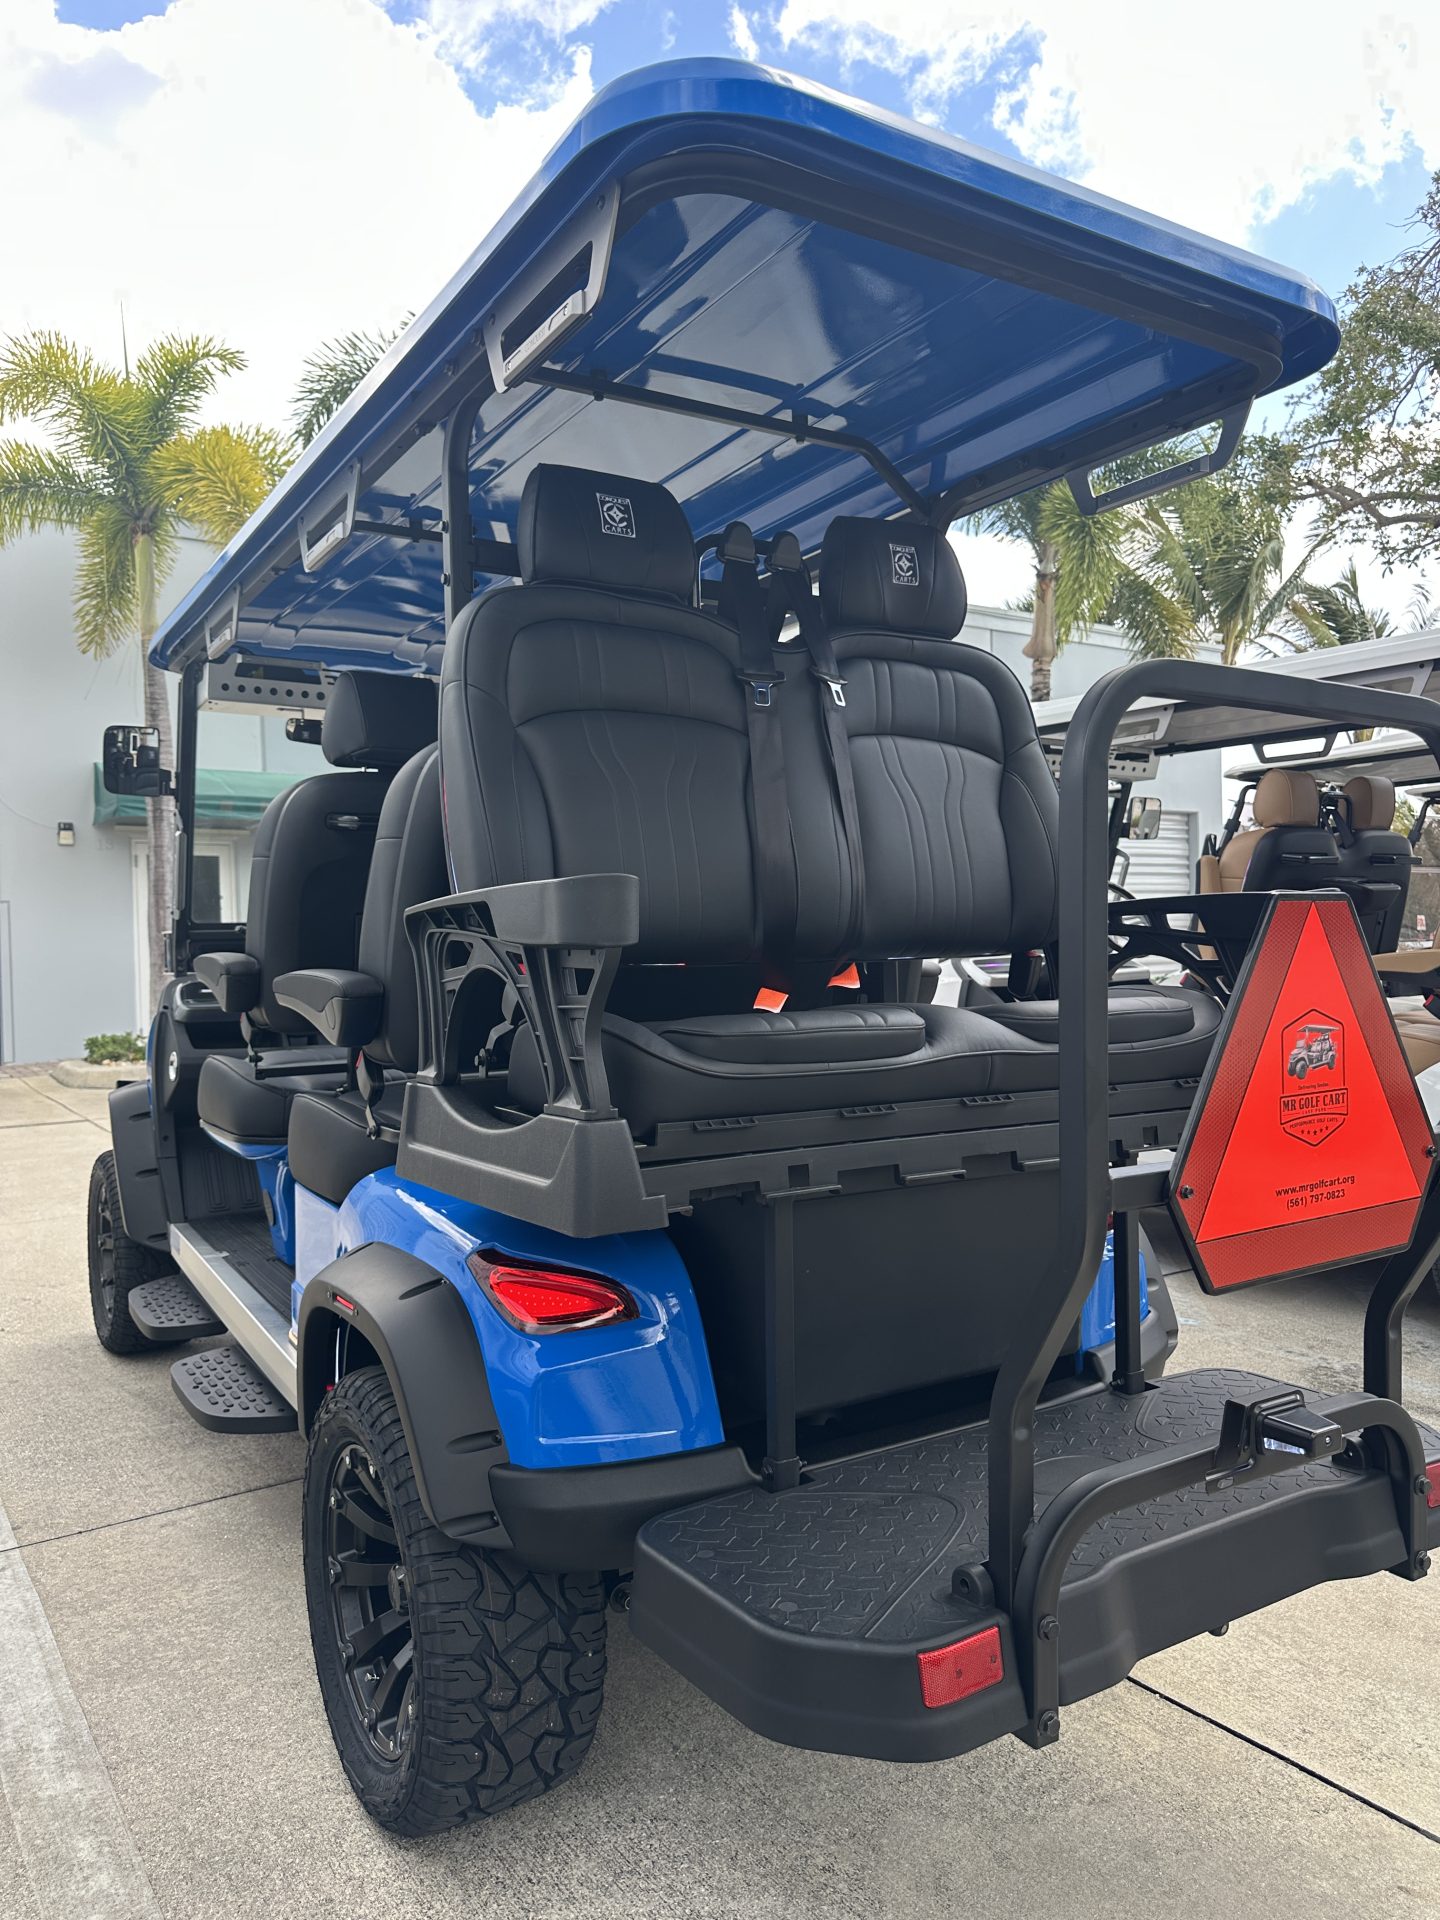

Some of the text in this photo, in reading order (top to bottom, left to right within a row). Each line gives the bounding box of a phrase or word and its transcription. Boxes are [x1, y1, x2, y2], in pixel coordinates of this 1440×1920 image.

[1282, 1092, 1346, 1112] MR GOLF CART
[1275, 1175, 1355, 1197] www.mrgolfcart.org
[1286, 1189, 1346, 1211] (561) 797-0823
